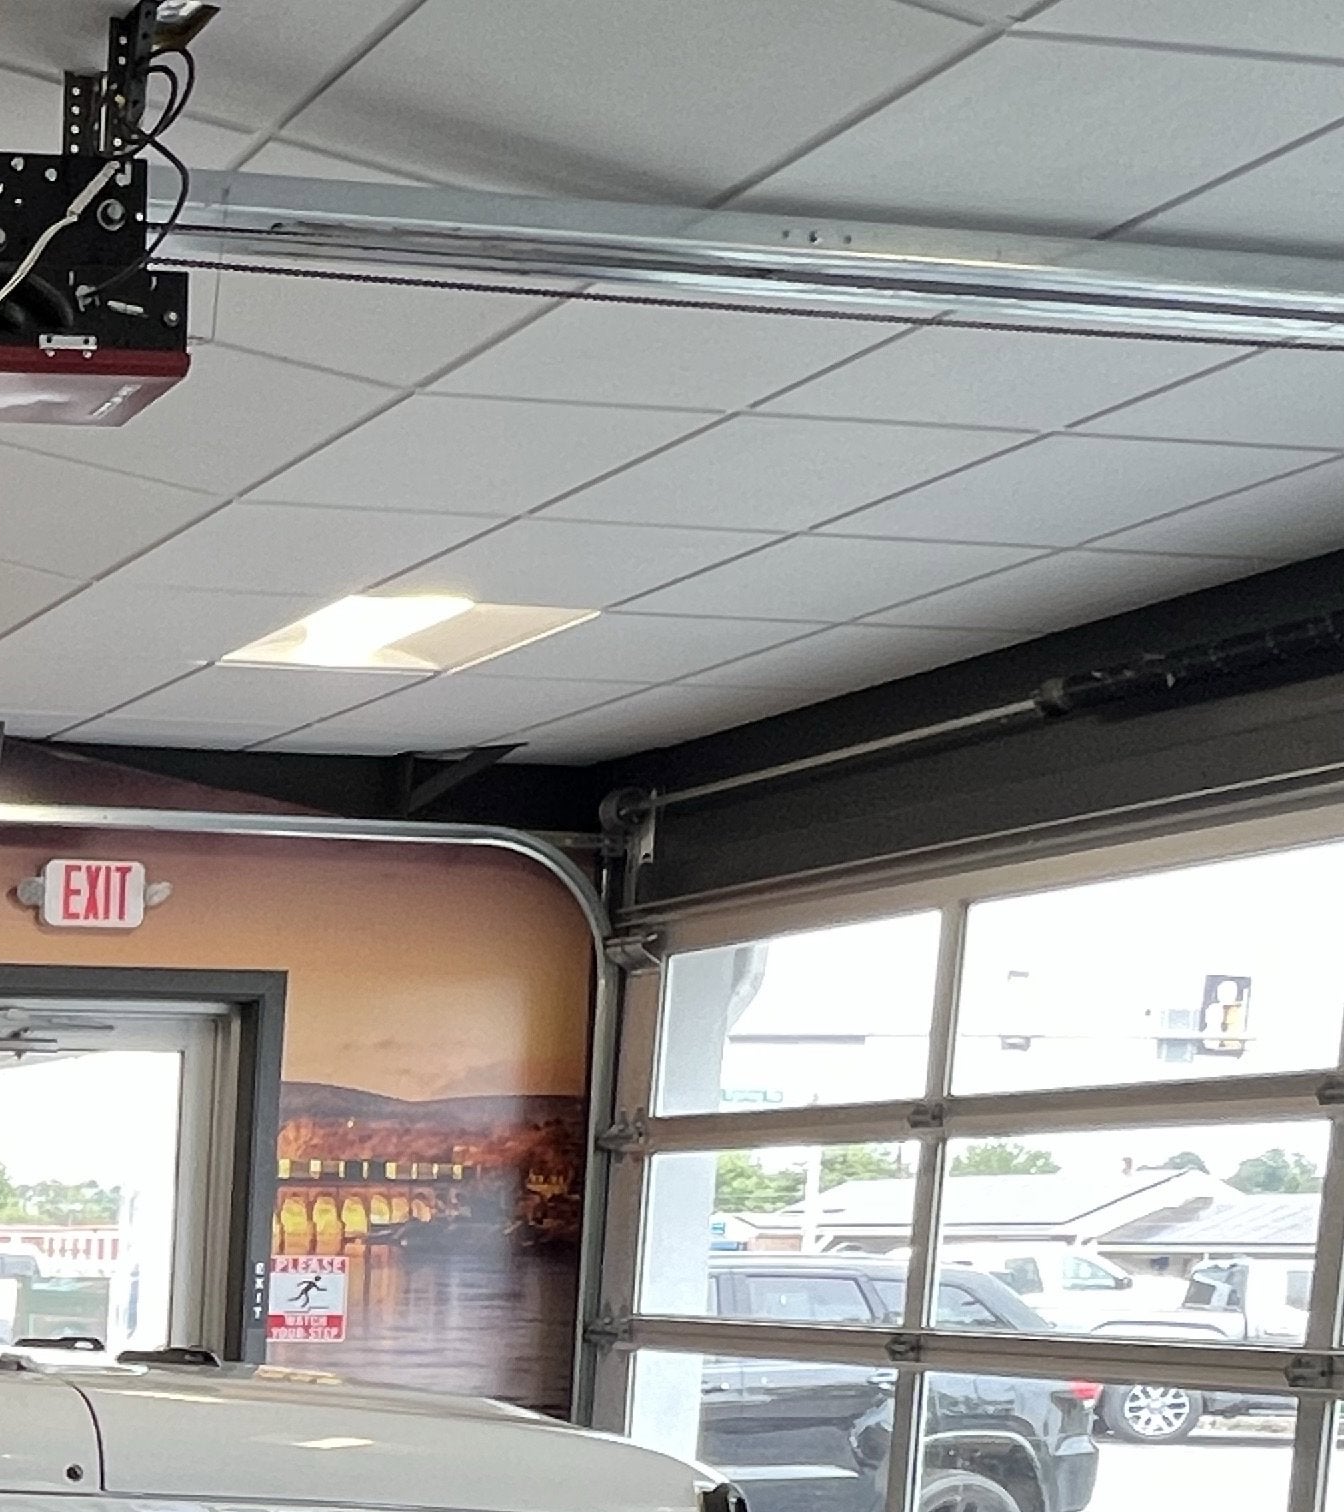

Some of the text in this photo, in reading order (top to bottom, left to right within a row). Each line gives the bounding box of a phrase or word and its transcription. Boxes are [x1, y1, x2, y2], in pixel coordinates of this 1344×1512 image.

[62, 864, 133, 921] EXIT
[253, 1262, 265, 1320] EXIT
[274, 1258, 345, 1273] PLEASE
